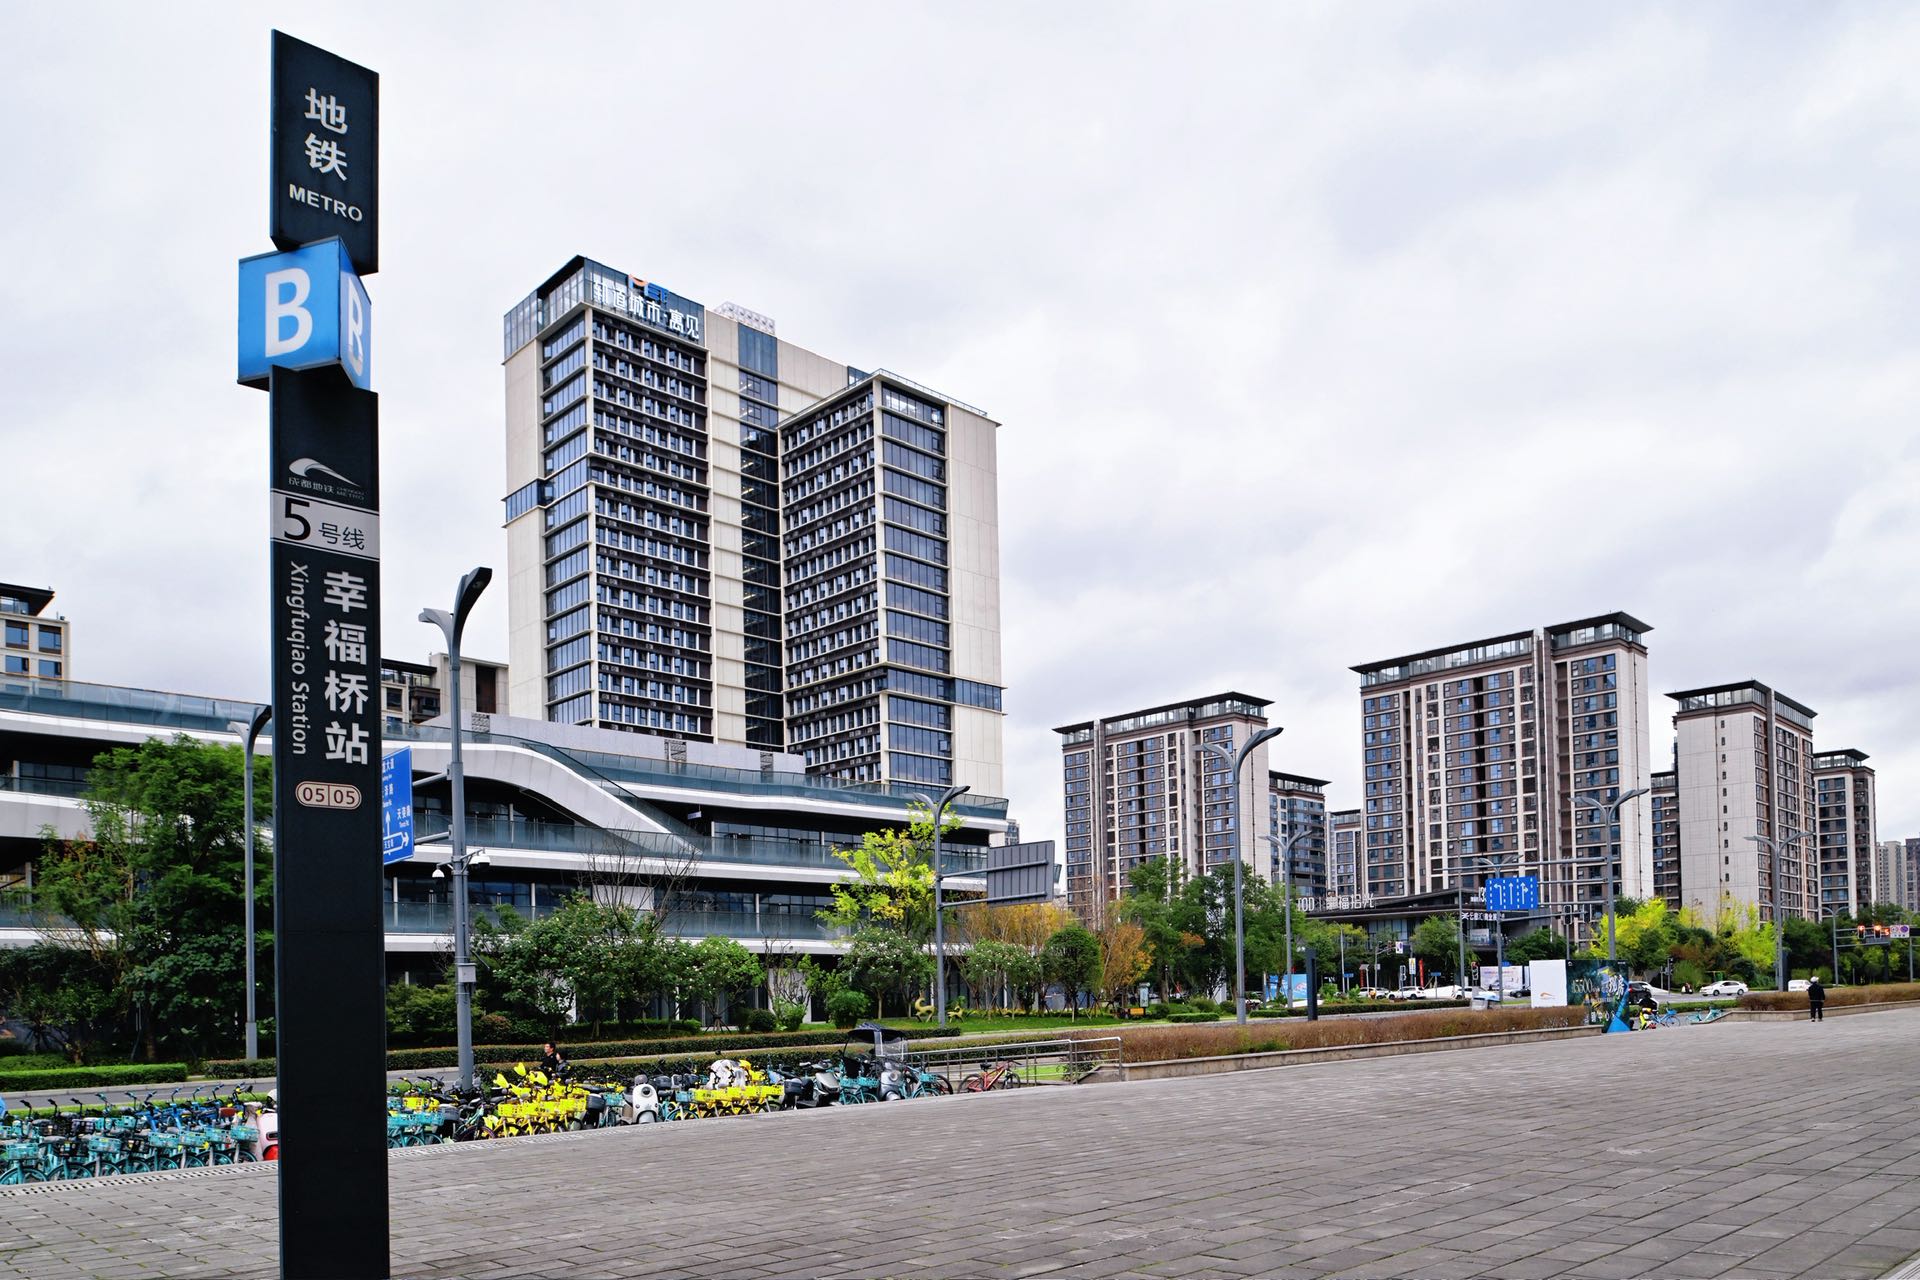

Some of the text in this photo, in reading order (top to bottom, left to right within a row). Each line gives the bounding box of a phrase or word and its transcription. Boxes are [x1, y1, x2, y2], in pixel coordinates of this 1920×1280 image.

[304, 87, 348, 182] 地铁
[289, 183, 364, 223] METRO
[265, 267, 313, 359] B
[348, 278, 365, 377] B
[288, 476, 335, 495] 成都地铁
[287, 560, 310, 756] Xingfuqiao Station
[323, 570, 370, 766] 幸福桥站
[302, 787, 356, 806] 05 05
